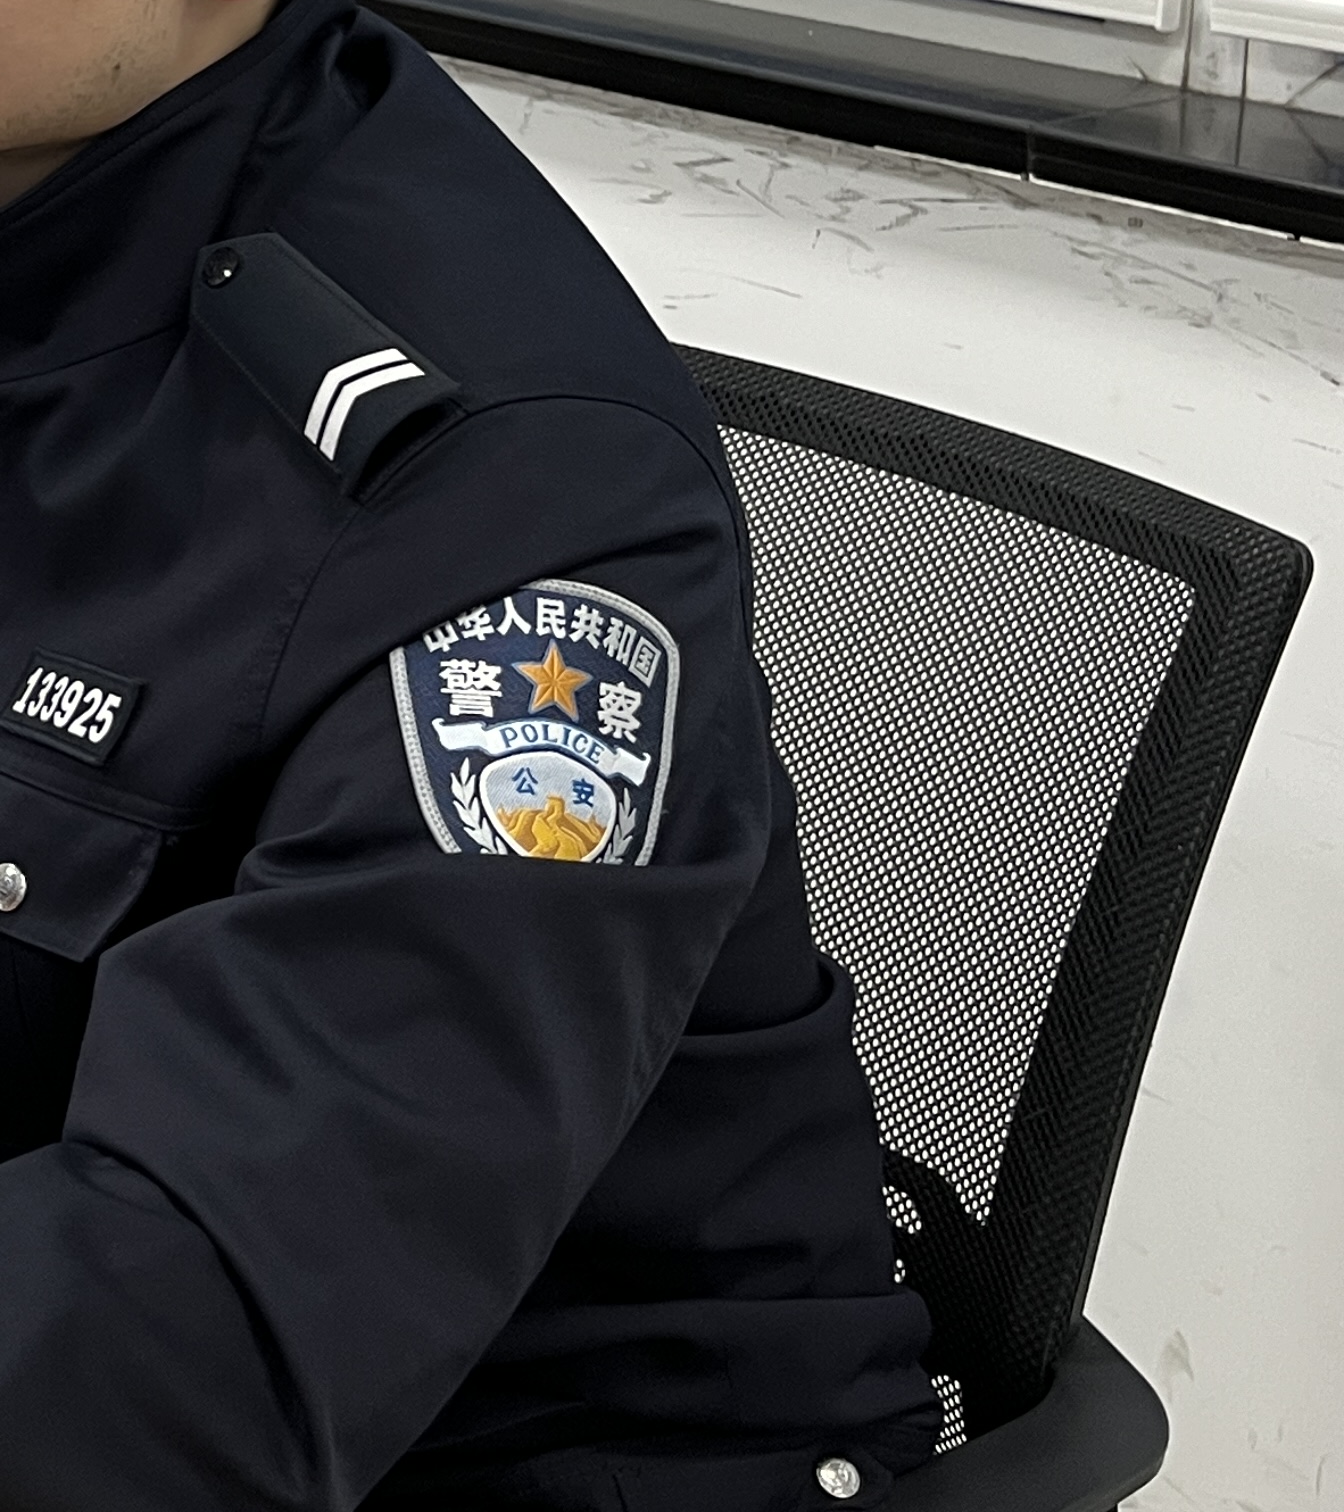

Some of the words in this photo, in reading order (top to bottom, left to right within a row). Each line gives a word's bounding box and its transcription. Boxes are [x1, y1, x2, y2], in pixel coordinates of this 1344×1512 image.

[422, 595, 662, 688] 中华人民共和国
[12, 667, 122, 744] 133925
[499, 724, 608, 766] POLICE
